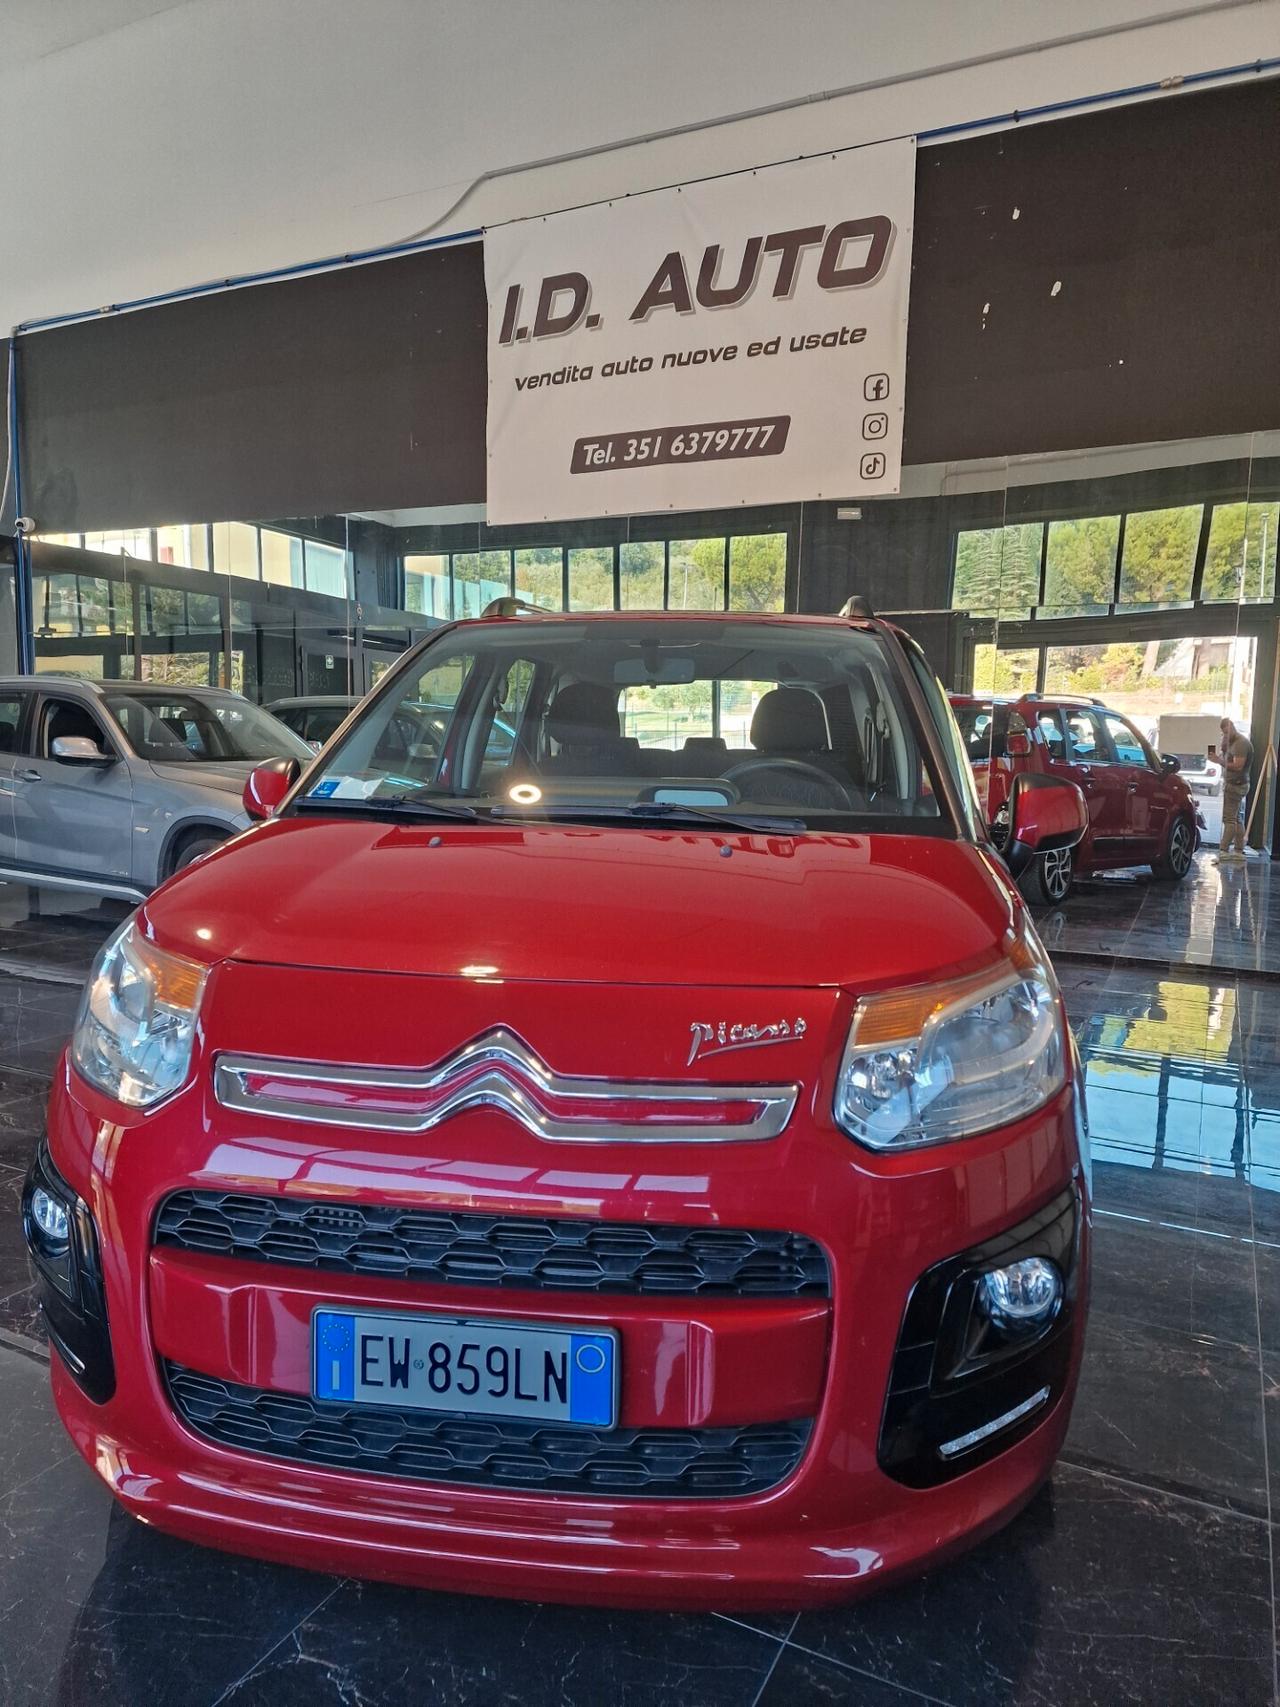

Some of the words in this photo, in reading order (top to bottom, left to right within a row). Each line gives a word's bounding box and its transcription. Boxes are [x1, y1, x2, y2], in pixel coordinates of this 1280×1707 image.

[498, 272, 602, 346] I.D.
[628, 215, 897, 321] AUTO
[515, 365, 593, 391] vendita
[601, 356, 653, 377] auto
[661, 345, 738, 369] nuove
[747, 336, 781, 357] ed
[789, 326, 867, 353] usate
[583, 442, 616, 466] Tel.
[624, 436, 662, 462] 351
[670, 424, 775, 456] 6379777
[360, 1334, 410, 1389] EW
[428, 1341, 568, 1404] 859LN
